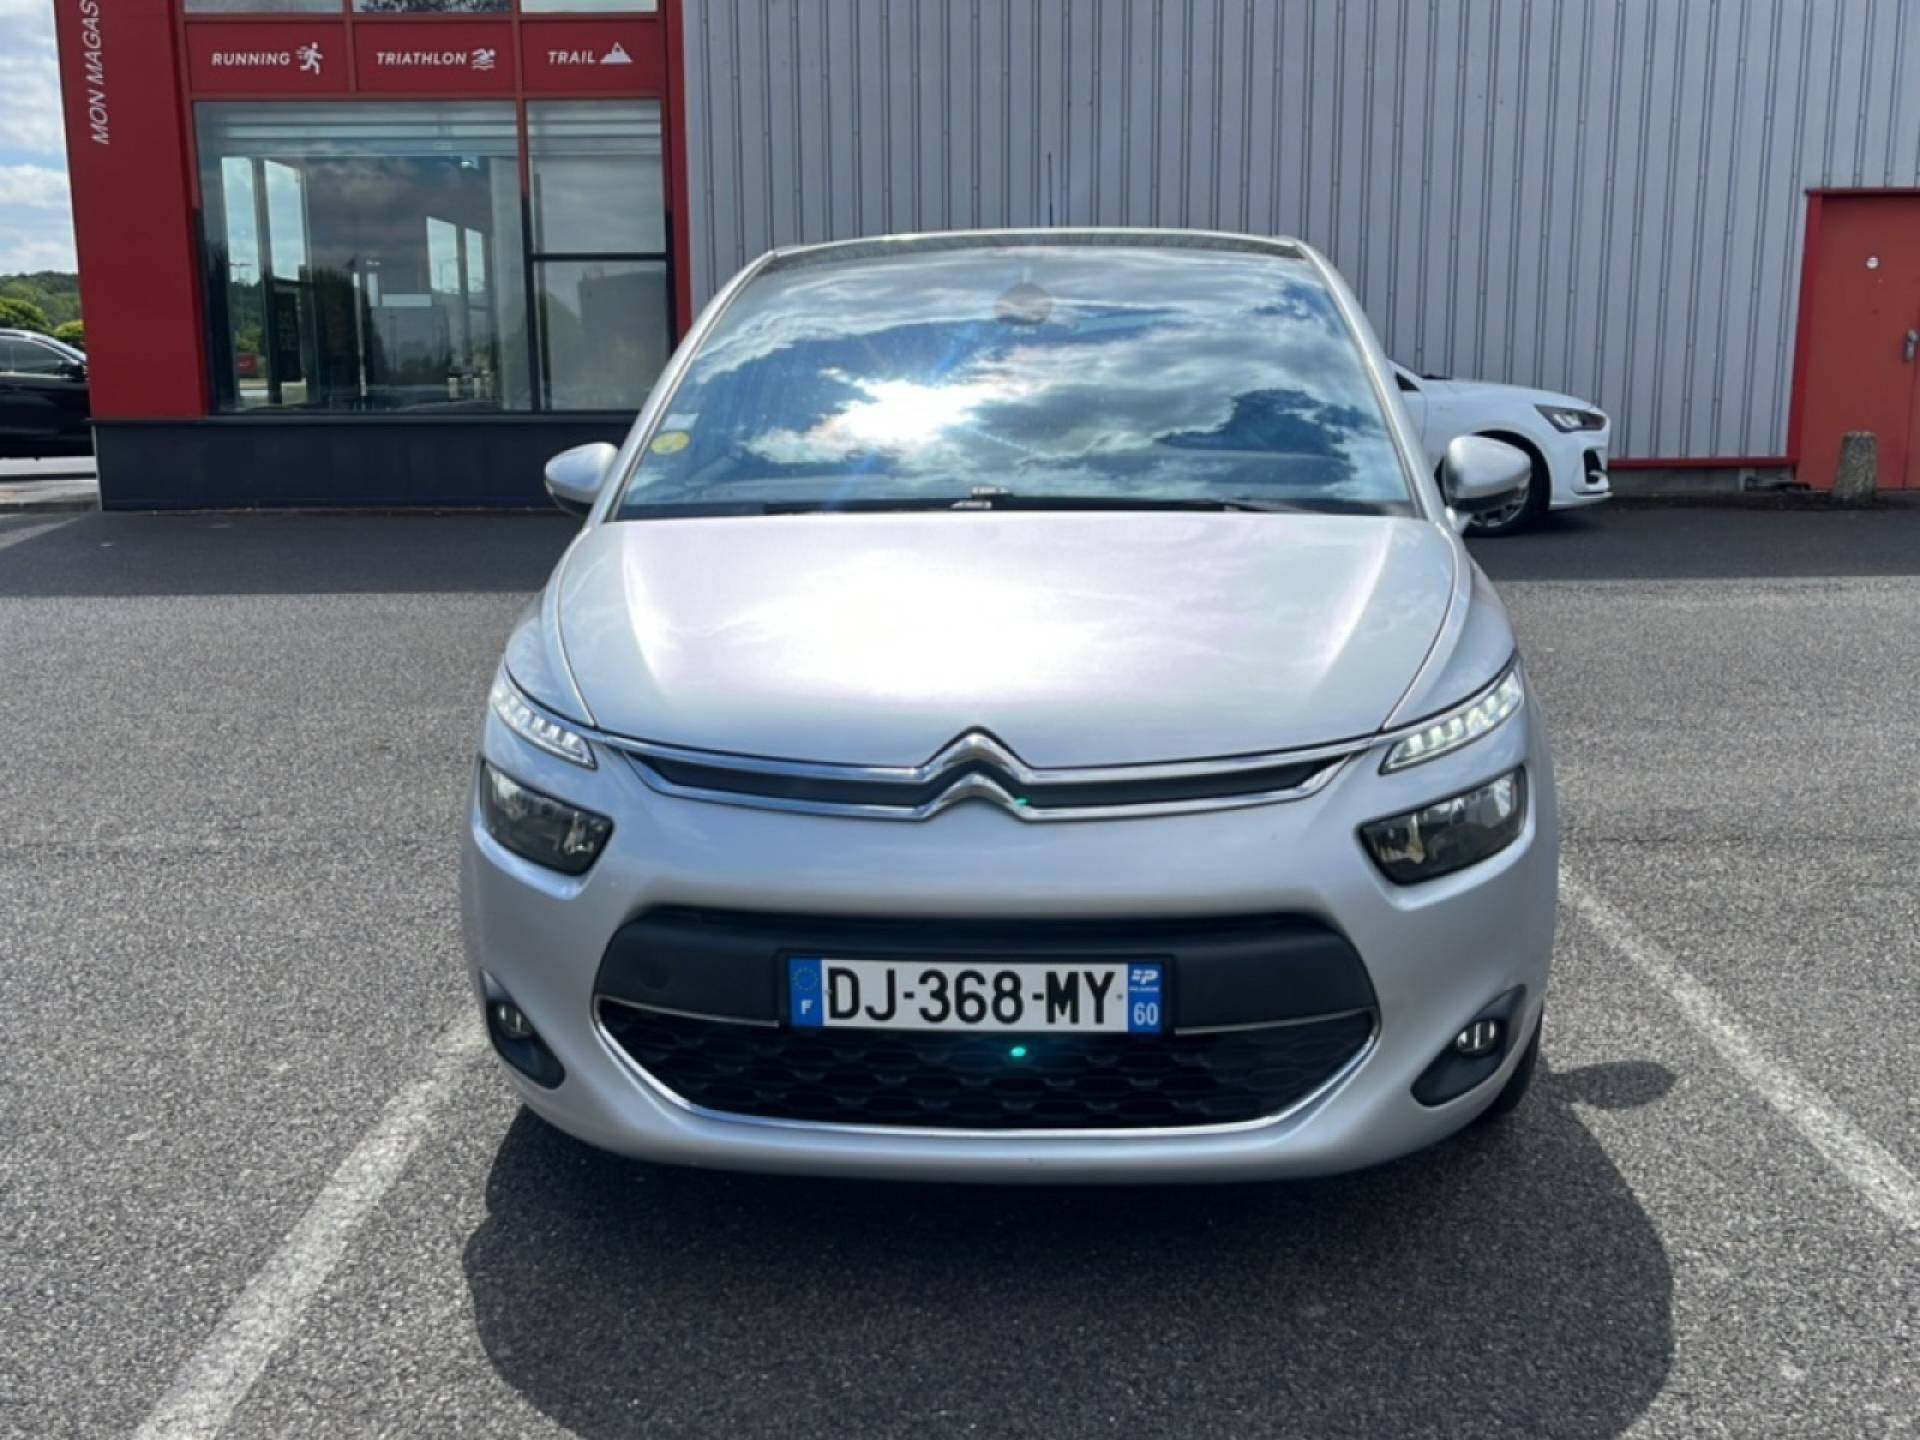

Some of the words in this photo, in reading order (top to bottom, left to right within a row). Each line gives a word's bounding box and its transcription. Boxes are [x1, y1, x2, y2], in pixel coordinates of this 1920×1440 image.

[80, 0, 105, 85] MAGAS
[211, 52, 291, 66] RUNNING
[376, 51, 468, 66] TRIATHLON
[547, 50, 596, 65] TRAIL
[88, 89, 111, 145] MON
[828, 966, 1115, 1025] DJ-368-MY
[801, 999, 813, 1016] F
[1133, 1002, 1159, 1026] 60
